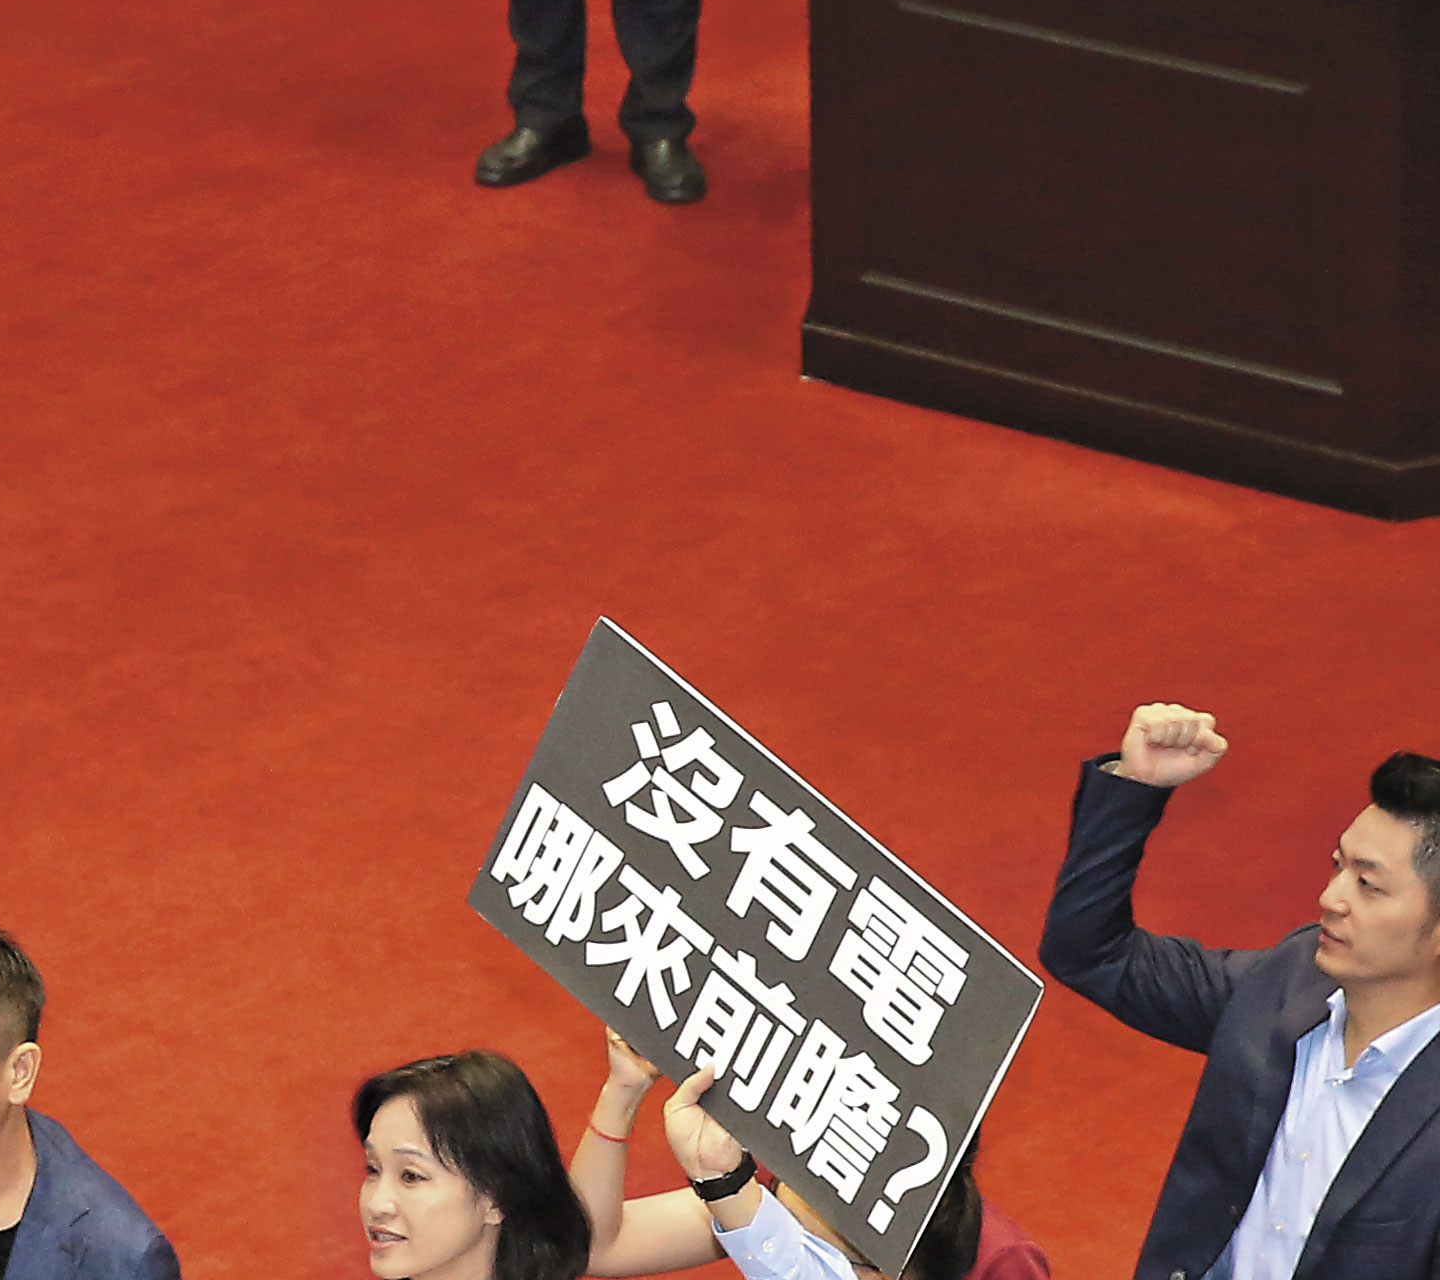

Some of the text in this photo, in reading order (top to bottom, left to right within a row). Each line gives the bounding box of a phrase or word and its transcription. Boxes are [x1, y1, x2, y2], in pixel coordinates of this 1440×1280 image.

[489, 781, 949, 1235] 哪來前瞻?
[602, 700, 970, 1067] 沒有電
